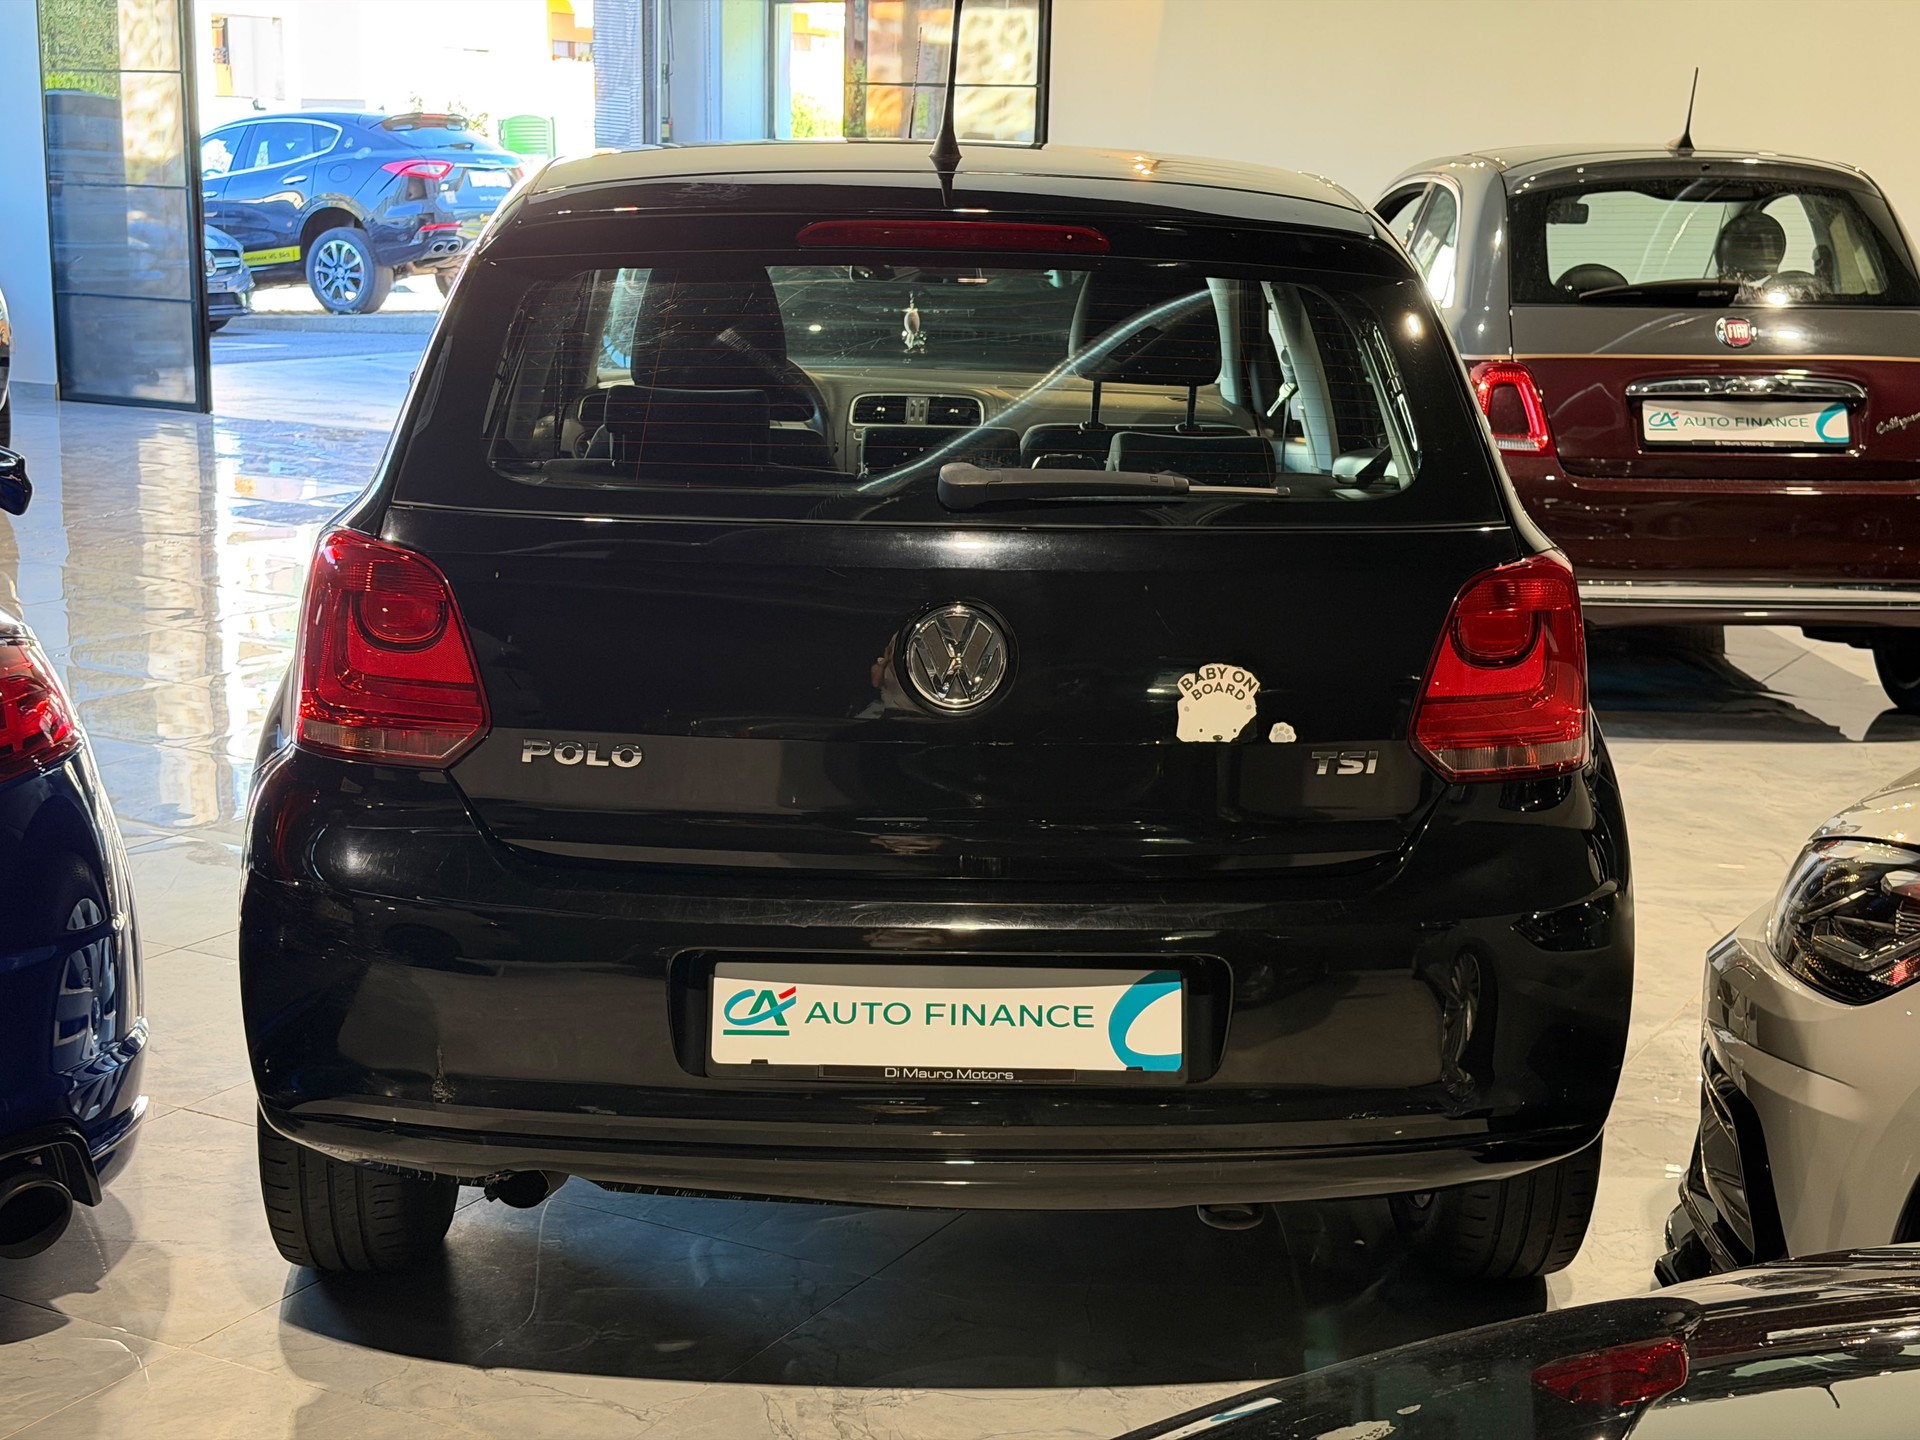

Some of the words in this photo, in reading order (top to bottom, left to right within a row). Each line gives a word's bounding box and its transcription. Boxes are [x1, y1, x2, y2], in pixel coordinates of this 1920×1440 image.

[1726, 322, 1749, 339] FIAT
[1683, 416, 1730, 427] AUTO
[1735, 416, 1810, 428] FINANCE
[1180, 667, 1228, 692] BABY
[1232, 670, 1258, 693] ON
[1191, 682, 1246, 701] BOARD
[522, 738, 643, 768] POLO
[1312, 751, 1379, 775] TSI
[804, 1001, 912, 1025] AUTO
[925, 1003, 1095, 1028] FINANCE
[884, 1067, 900, 1078] Di
[903, 1068, 954, 1079] Mauro
[956, 1069, 1014, 1080] Motors
